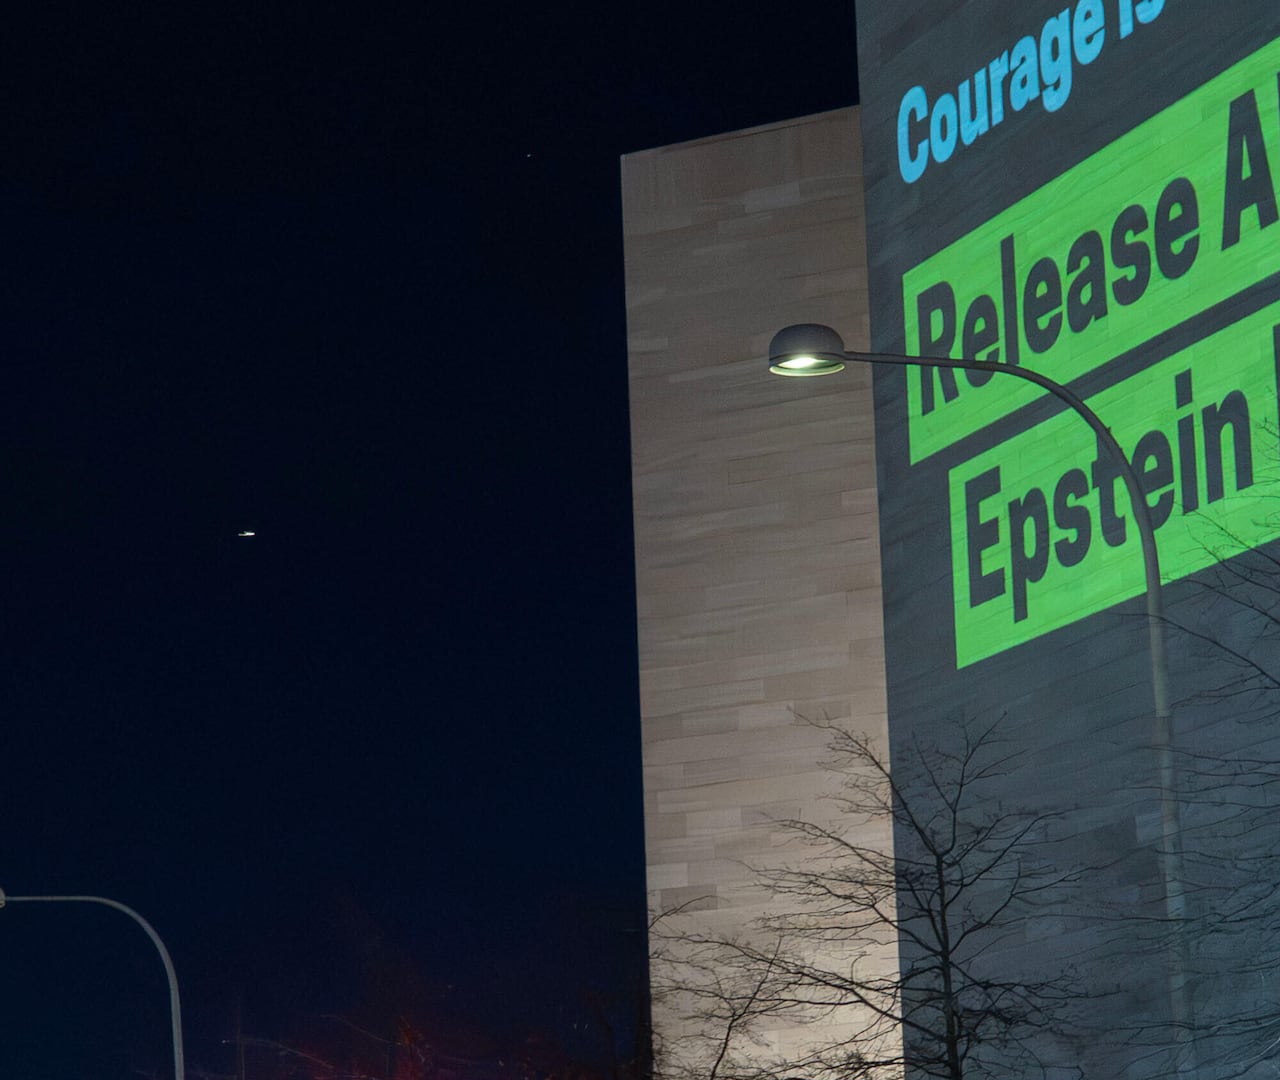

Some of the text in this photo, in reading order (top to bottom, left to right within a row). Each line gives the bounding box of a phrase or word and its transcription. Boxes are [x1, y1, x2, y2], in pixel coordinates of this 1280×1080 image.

[897, 0, 1105, 183] Courage
[917, 177, 1200, 417] Release
[965, 368, 1254, 624] Epstein
